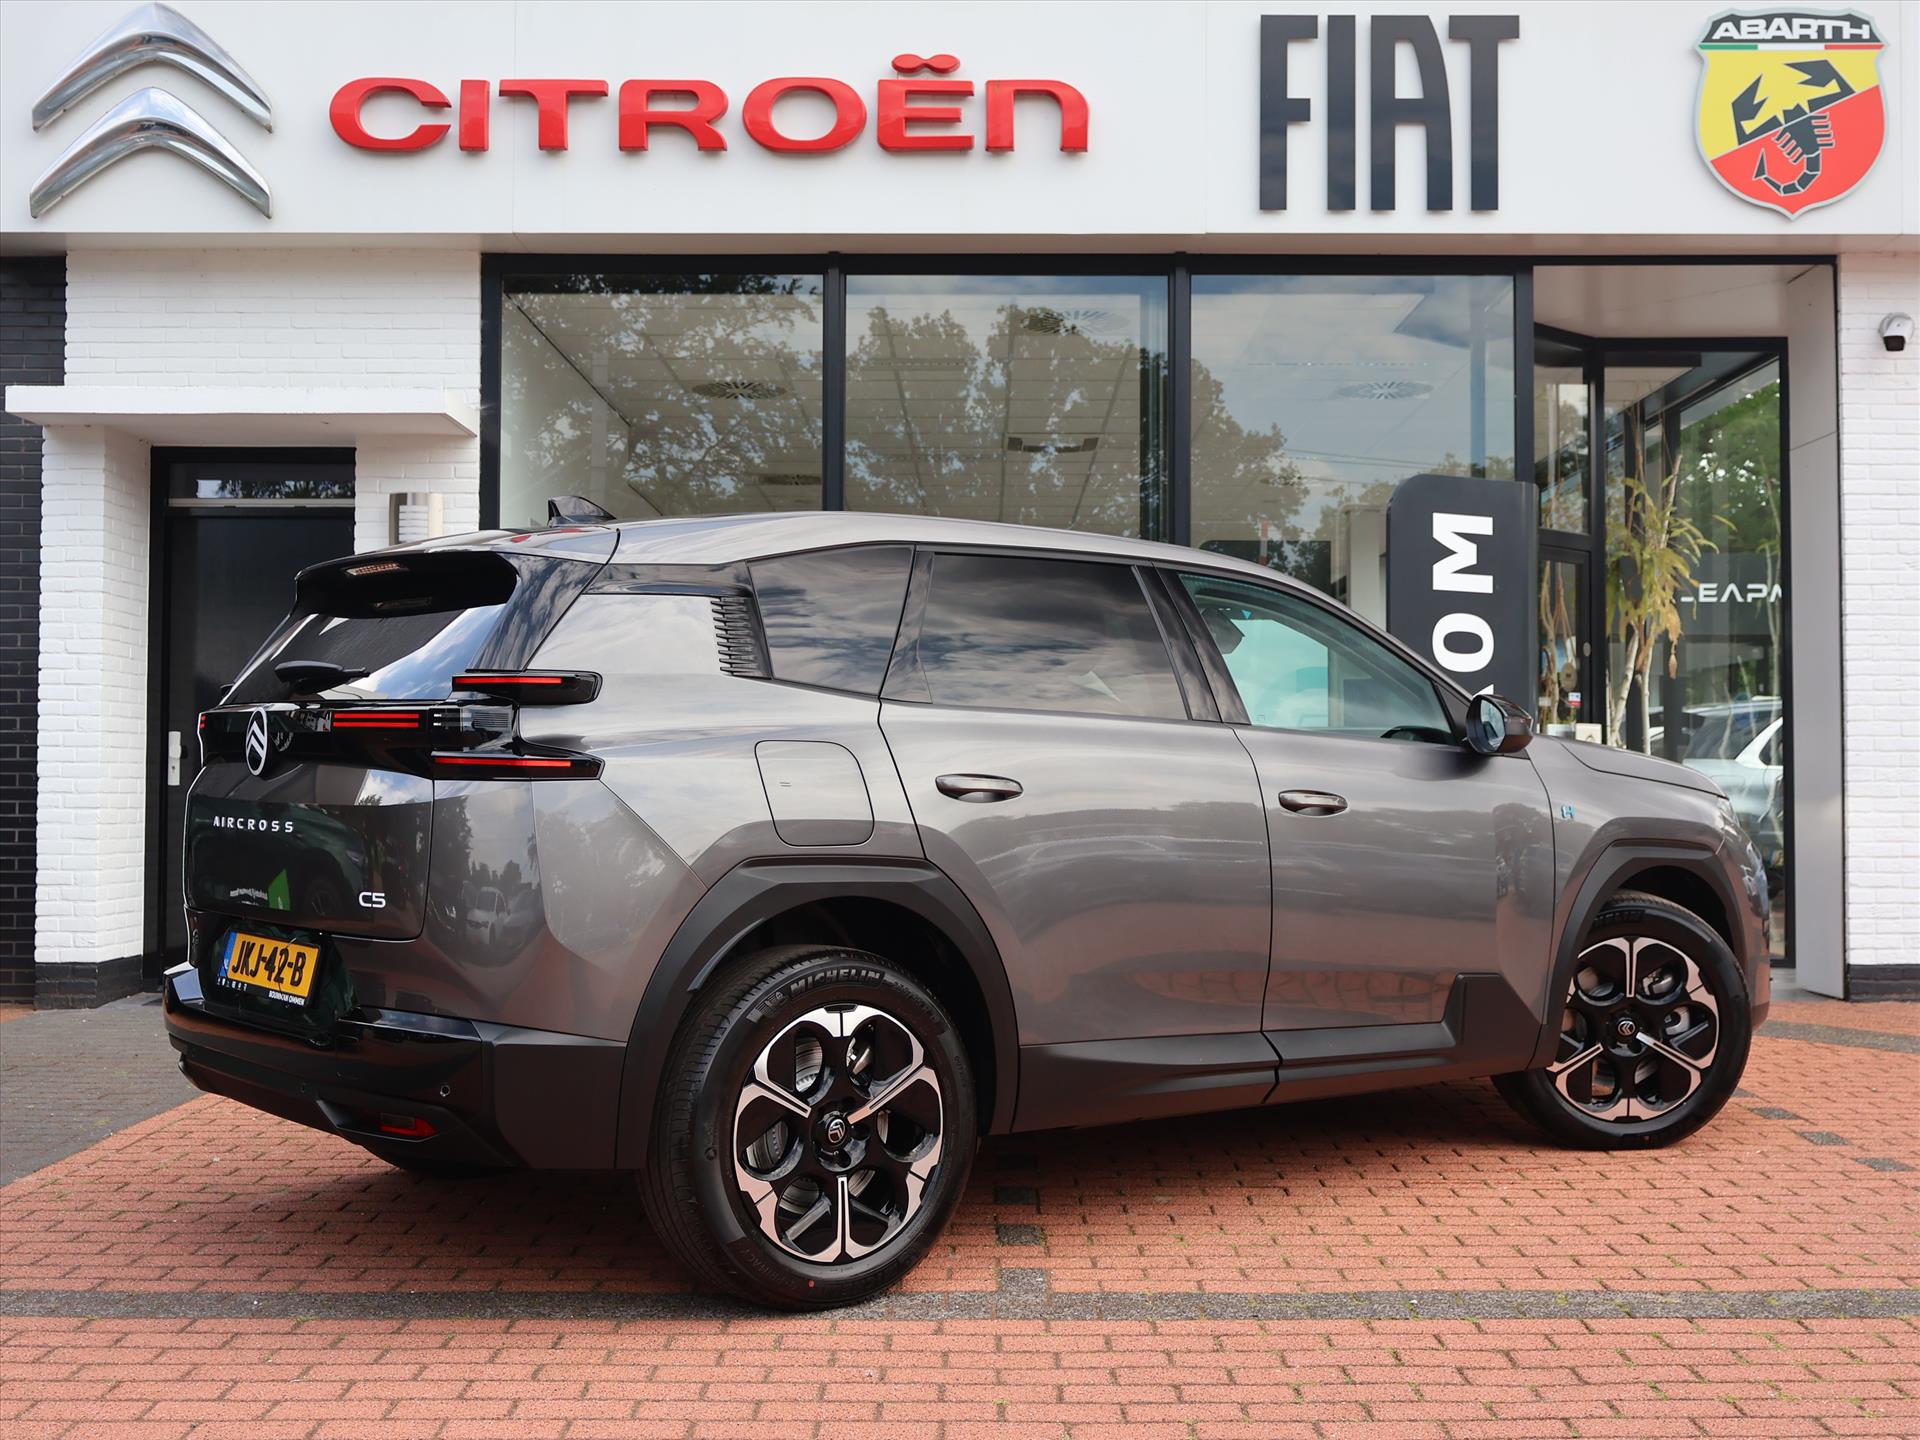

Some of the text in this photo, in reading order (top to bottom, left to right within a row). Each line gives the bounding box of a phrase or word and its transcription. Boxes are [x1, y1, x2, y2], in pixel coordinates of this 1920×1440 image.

[1711, 17, 1871, 40] ABARTH
[329, 53, 1089, 153] CITROËN
[1259, 14, 1520, 211] FIAT
[1432, 512, 1494, 696] OM
[213, 815, 294, 833] AIRCROSS
[358, 891, 386, 908] C5
[231, 939, 307, 988] JKJ-42-B
[789, 967, 881, 996] MICHELIN
